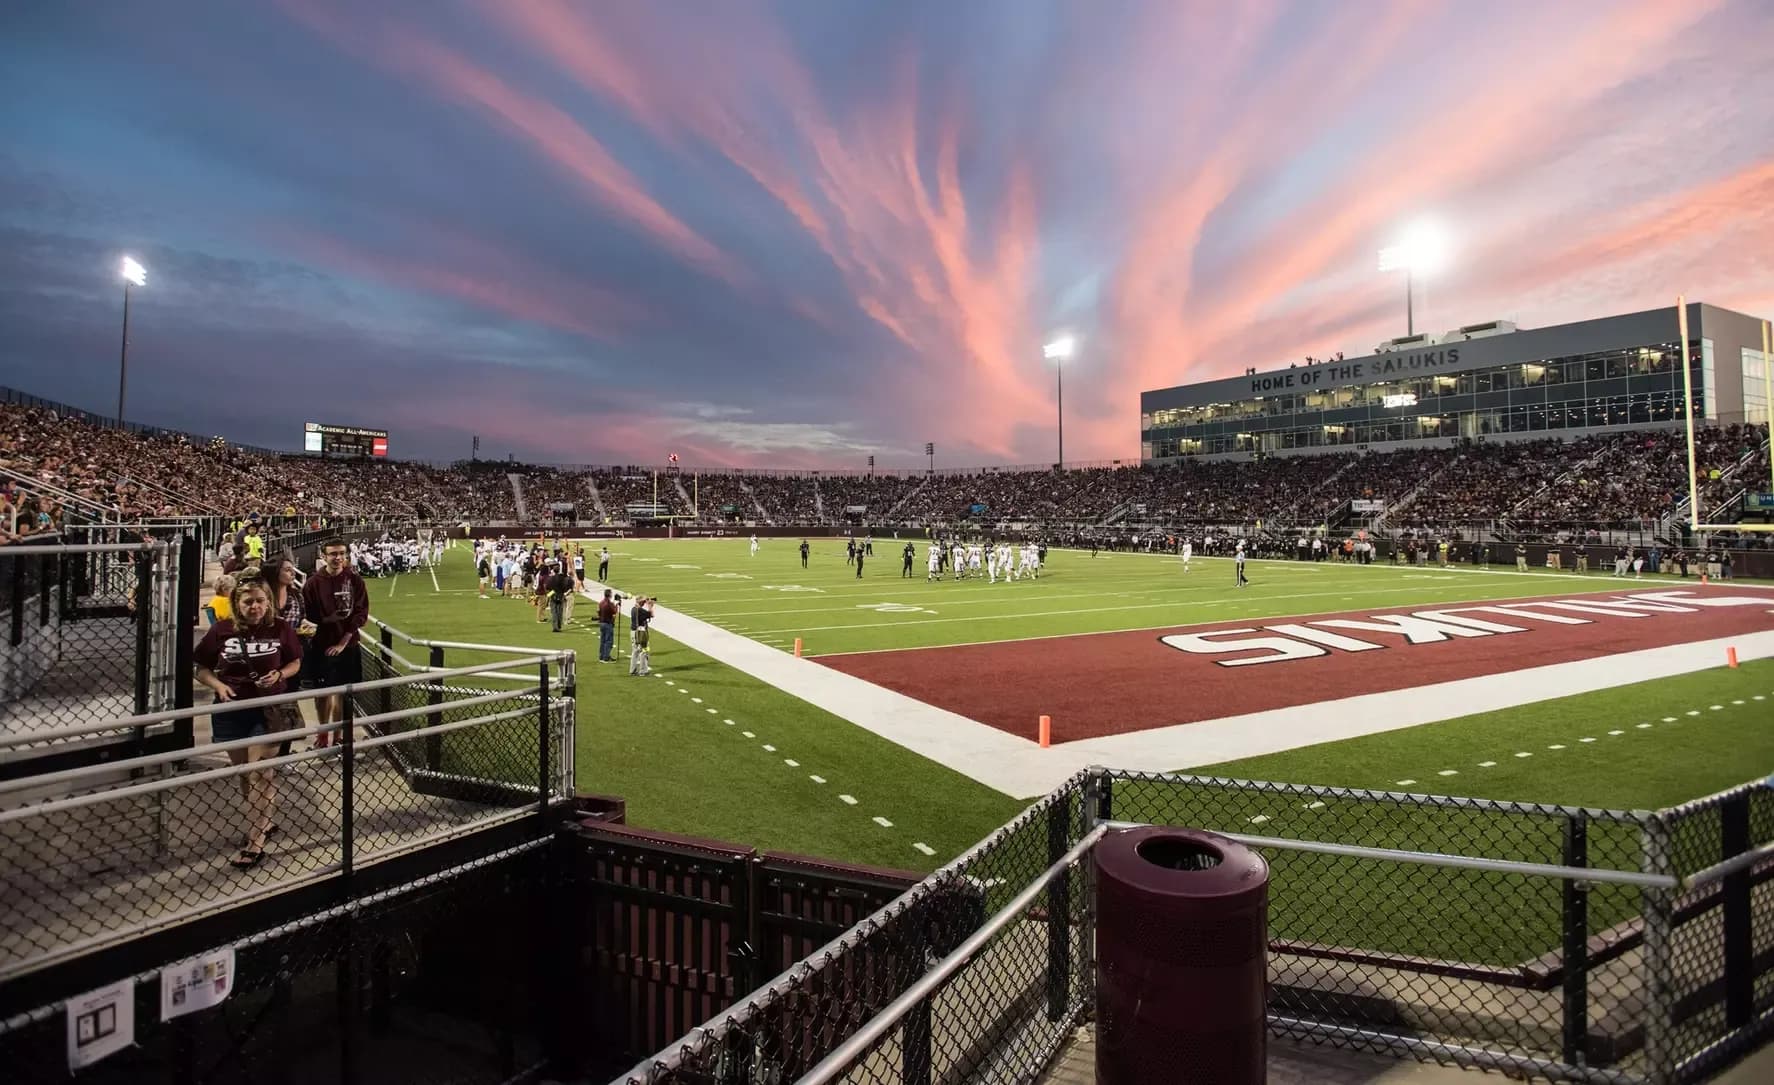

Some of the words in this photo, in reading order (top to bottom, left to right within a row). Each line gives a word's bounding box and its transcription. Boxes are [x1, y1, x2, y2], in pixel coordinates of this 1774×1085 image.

[1251, 375, 1295, 393] HOME
[1300, 369, 1322, 385] OF
[1328, 363, 1364, 380] THE
[1371, 349, 1460, 375] SALUKIS
[224, 637, 281, 656] SIU
